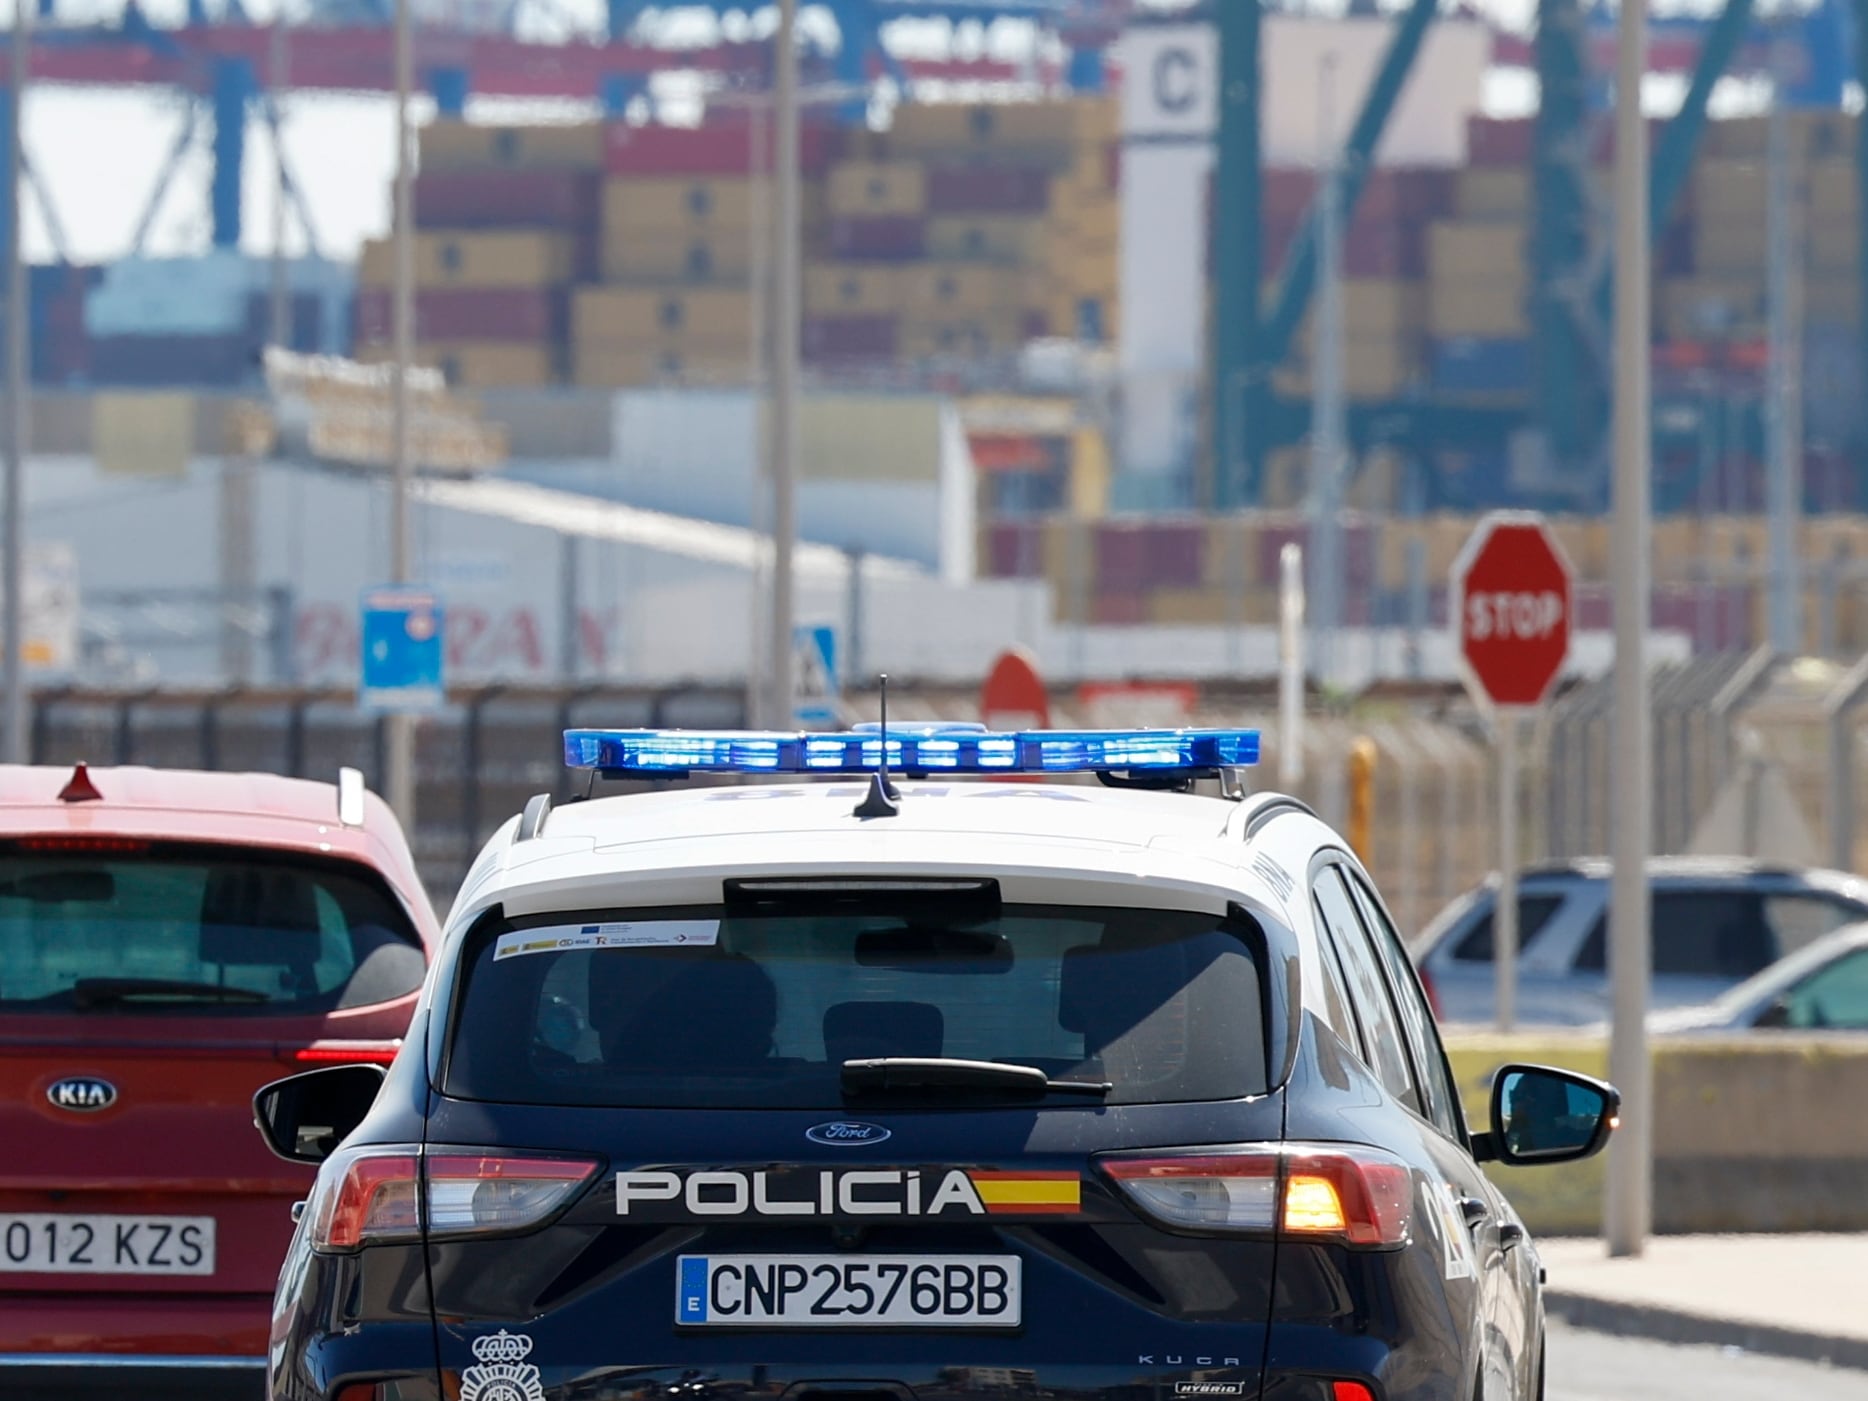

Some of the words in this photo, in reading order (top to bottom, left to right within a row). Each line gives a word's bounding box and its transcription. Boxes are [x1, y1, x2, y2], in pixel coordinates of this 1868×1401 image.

[1152, 45, 1199, 117] C
[1468, 590, 1564, 641] STOP
[58, 1082, 106, 1105] KIA
[825, 1122, 872, 1139] Ford
[615, 1170, 986, 1215] POLICÍA
[6, 1220, 94, 1263] 012
[115, 1223, 204, 1267] KZS
[687, 1297, 700, 1312] E
[710, 1263, 1009, 1316] CNP2576BB
[1180, 1384, 1237, 1393] HYBRID
